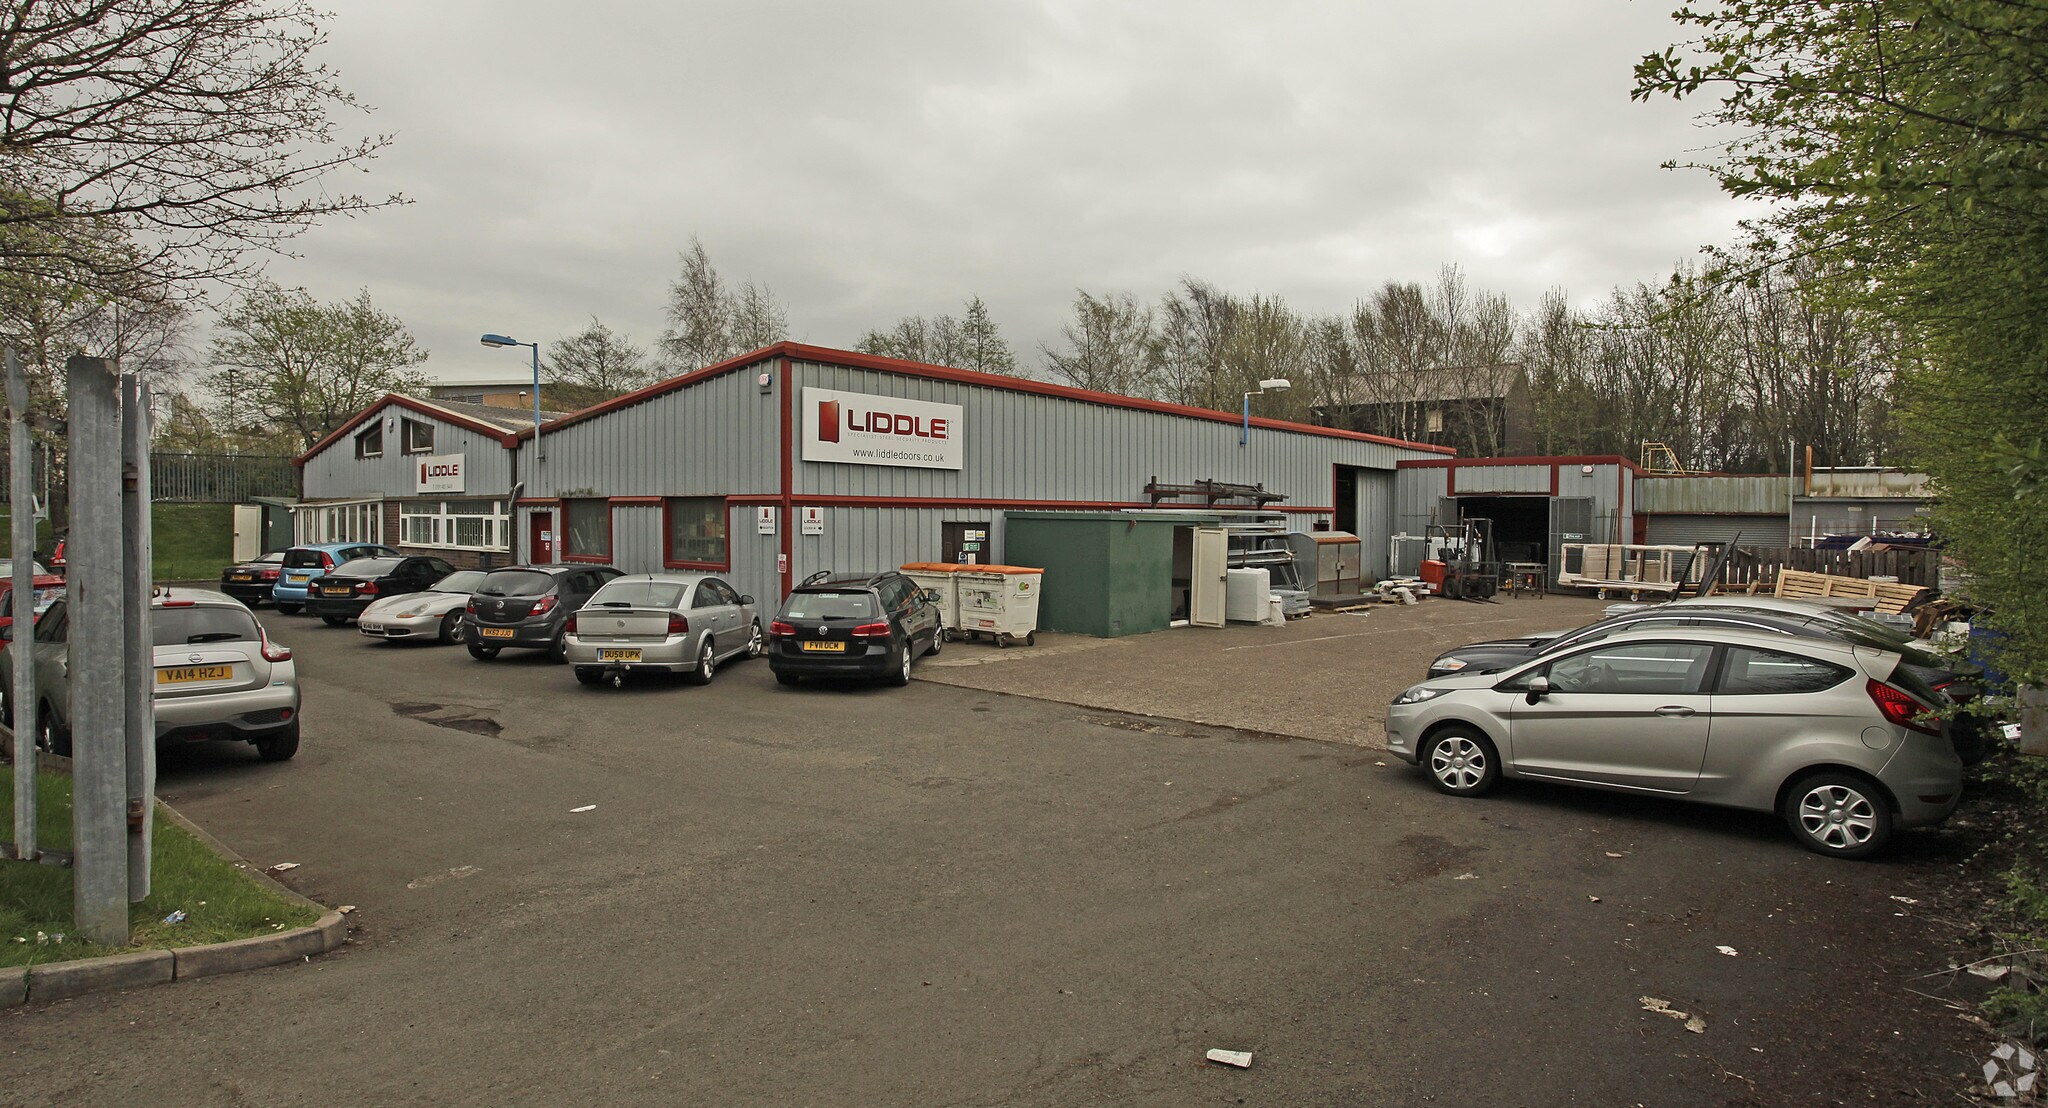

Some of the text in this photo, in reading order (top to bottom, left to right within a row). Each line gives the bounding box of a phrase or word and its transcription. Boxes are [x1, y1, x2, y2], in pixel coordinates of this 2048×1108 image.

[848, 409, 946, 439] LIDDLE
[853, 449, 945, 462] www.liddledoors.co.uk
[428, 464, 458, 477] LIDDLE
[604, 650, 641, 658] DU58 UPK
[166, 667, 225, 680] VA14 HZJ
